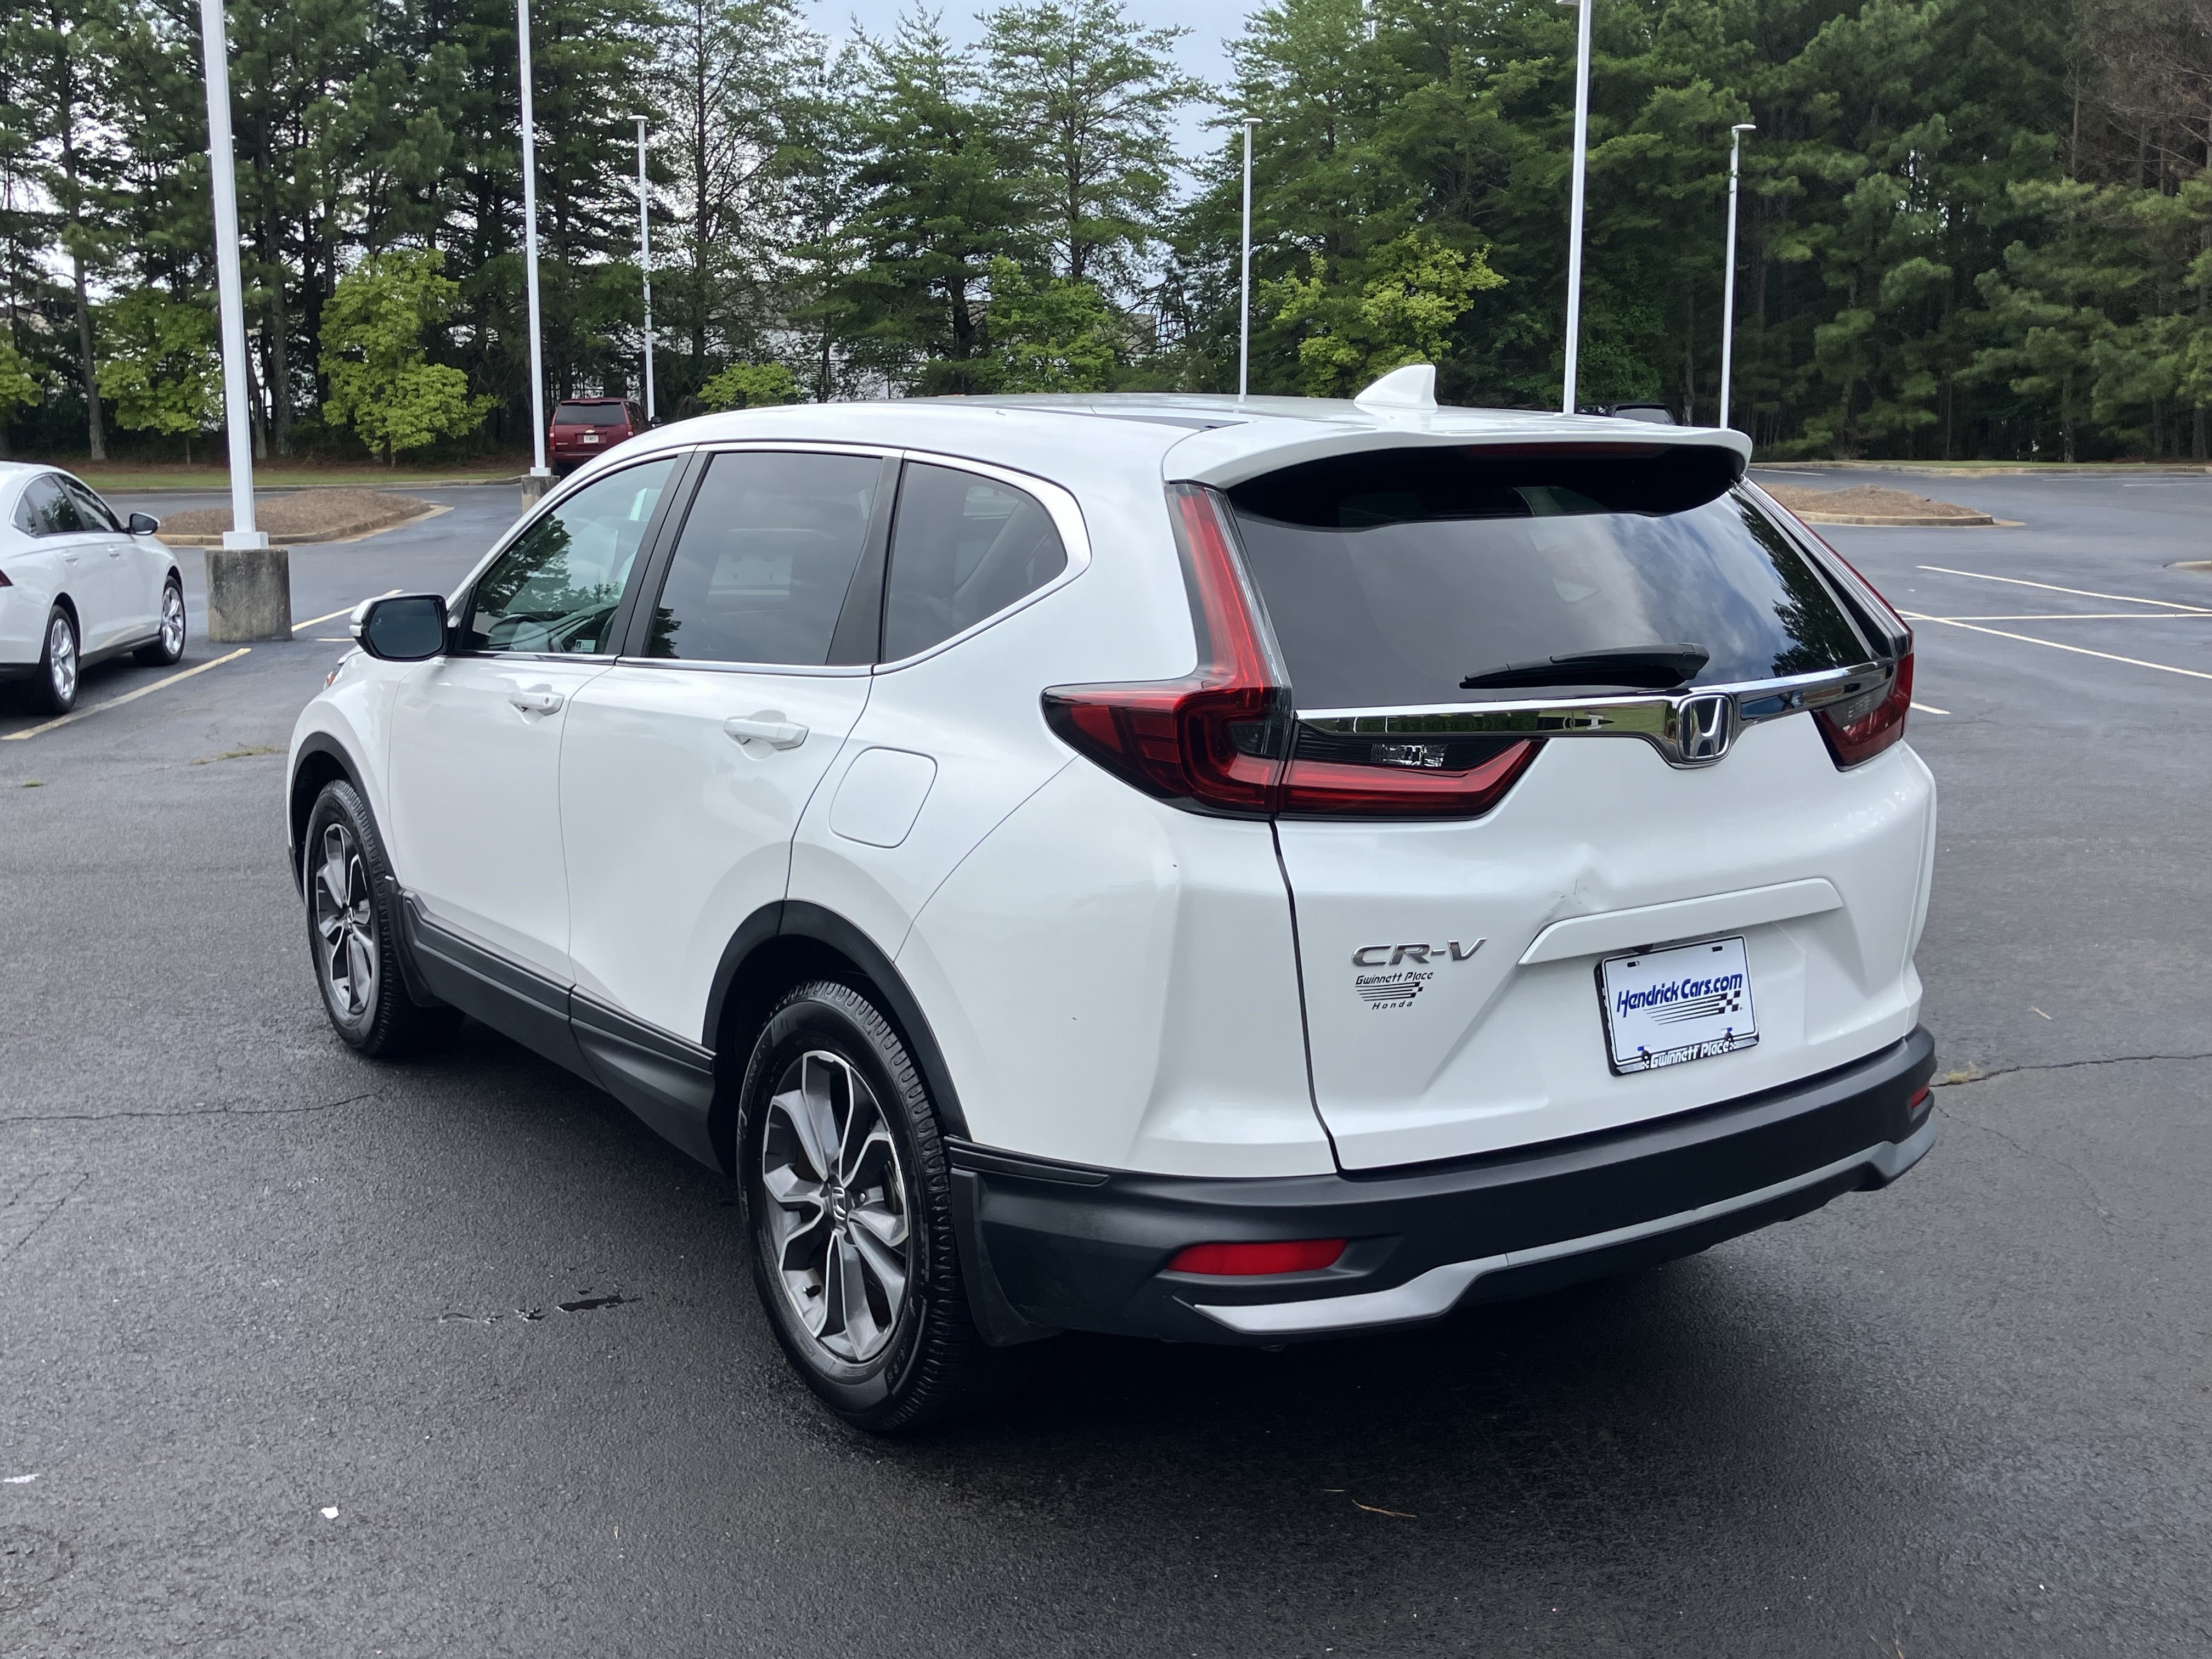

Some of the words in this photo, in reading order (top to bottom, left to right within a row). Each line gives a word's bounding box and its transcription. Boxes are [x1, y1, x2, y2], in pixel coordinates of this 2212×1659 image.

[1351, 936, 1488, 966] CR-V
[1355, 972, 1402, 985] Gwinnett
[1403, 971, 1434, 981] Place
[1372, 1000, 1413, 1010] Honda
[1650, 1044, 1700, 1069] Gwinnett
[1700, 1040, 1730, 1058] Place
